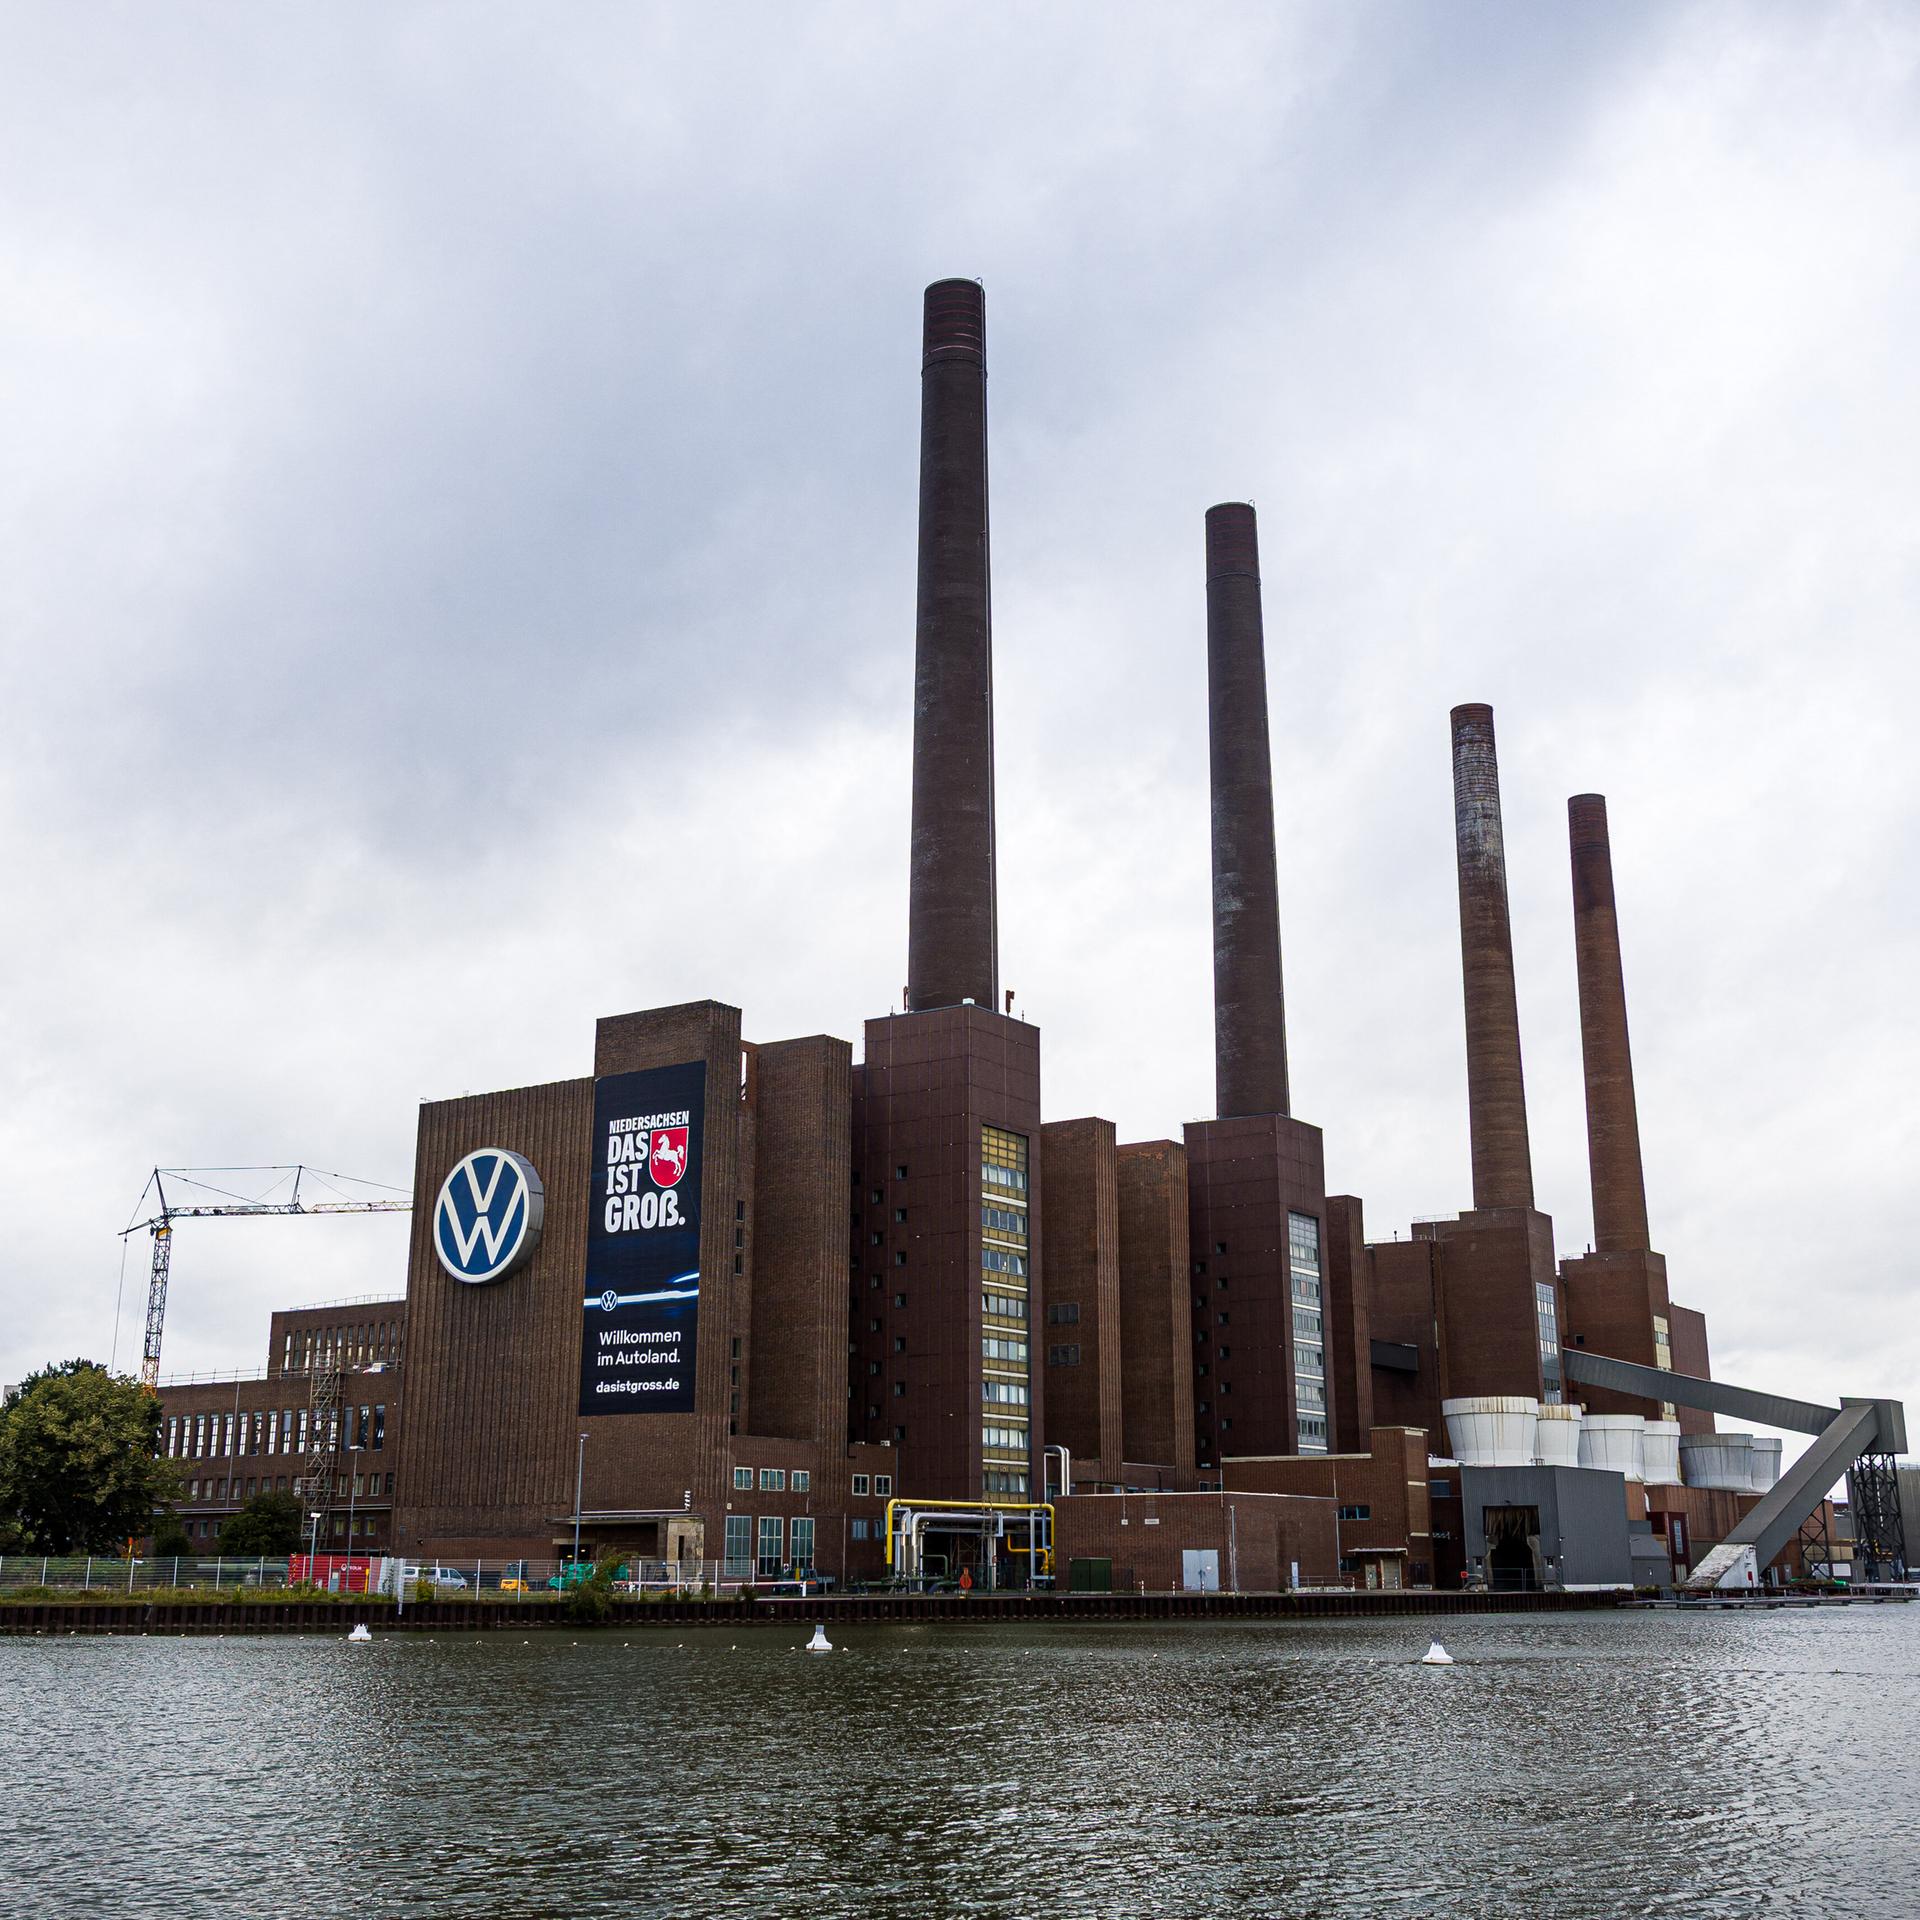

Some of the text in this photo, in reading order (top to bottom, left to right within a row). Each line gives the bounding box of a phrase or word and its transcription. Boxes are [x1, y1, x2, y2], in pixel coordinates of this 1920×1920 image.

[609, 1110, 690, 1134] NIEDERSACHSEN
[607, 1131, 649, 1165] DAS
[606, 1162, 643, 1195] IST
[440, 1153, 526, 1269] VW
[599, 1329, 682, 1346] Willkommen
[597, 1348, 681, 1367] im Autoland.
[596, 1377, 680, 1394] dasistgross.de
